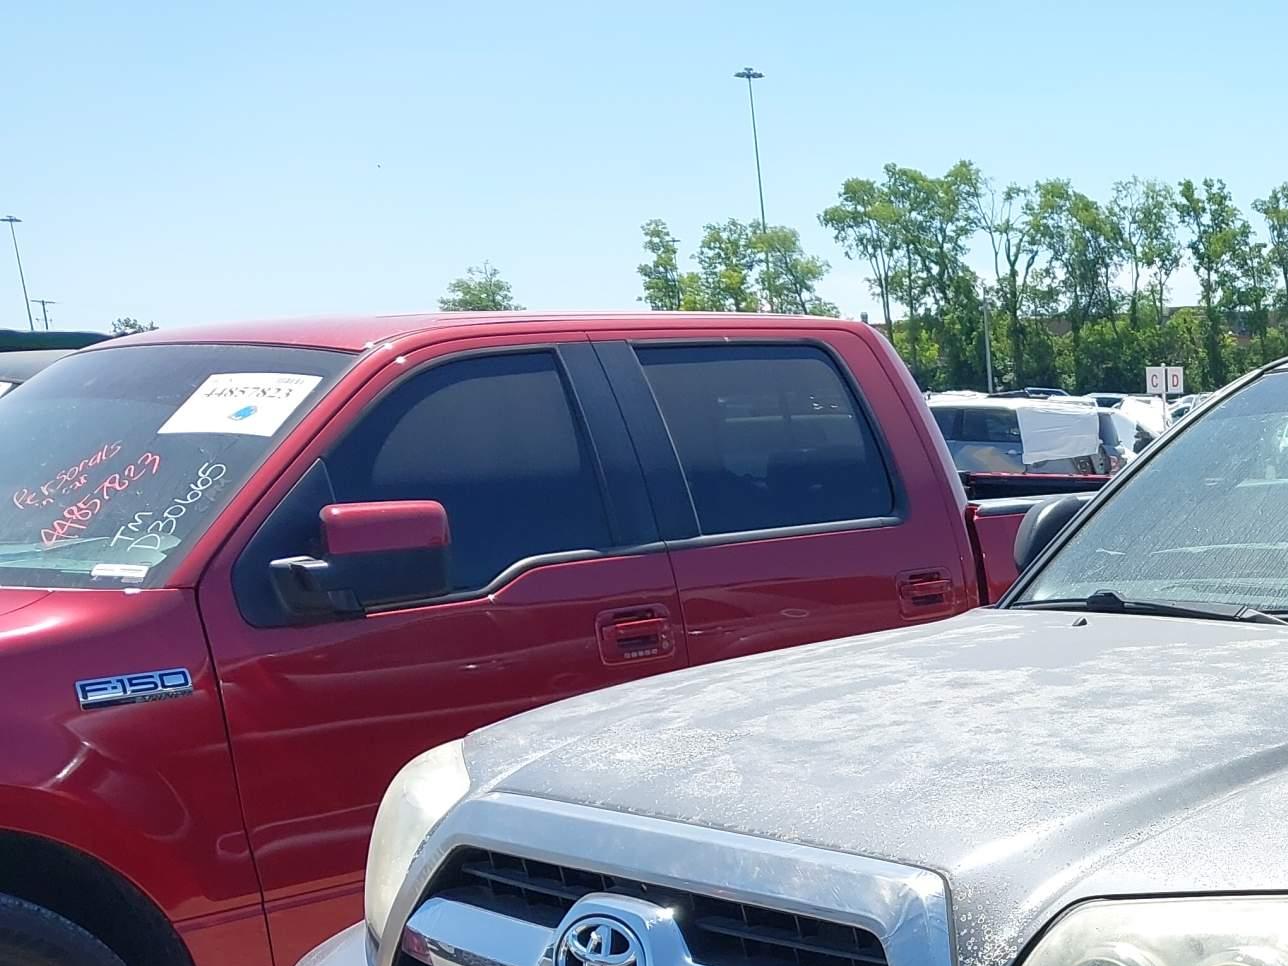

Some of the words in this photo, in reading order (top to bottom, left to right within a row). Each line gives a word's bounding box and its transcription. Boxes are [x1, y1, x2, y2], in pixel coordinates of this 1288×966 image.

[1151, 374, 1159, 388] C
[1171, 374, 1179, 388] D
[204, 386, 294, 399] 44857823
[127, 462, 227, 552] D30665
[79, 669, 190, 700] F-150
